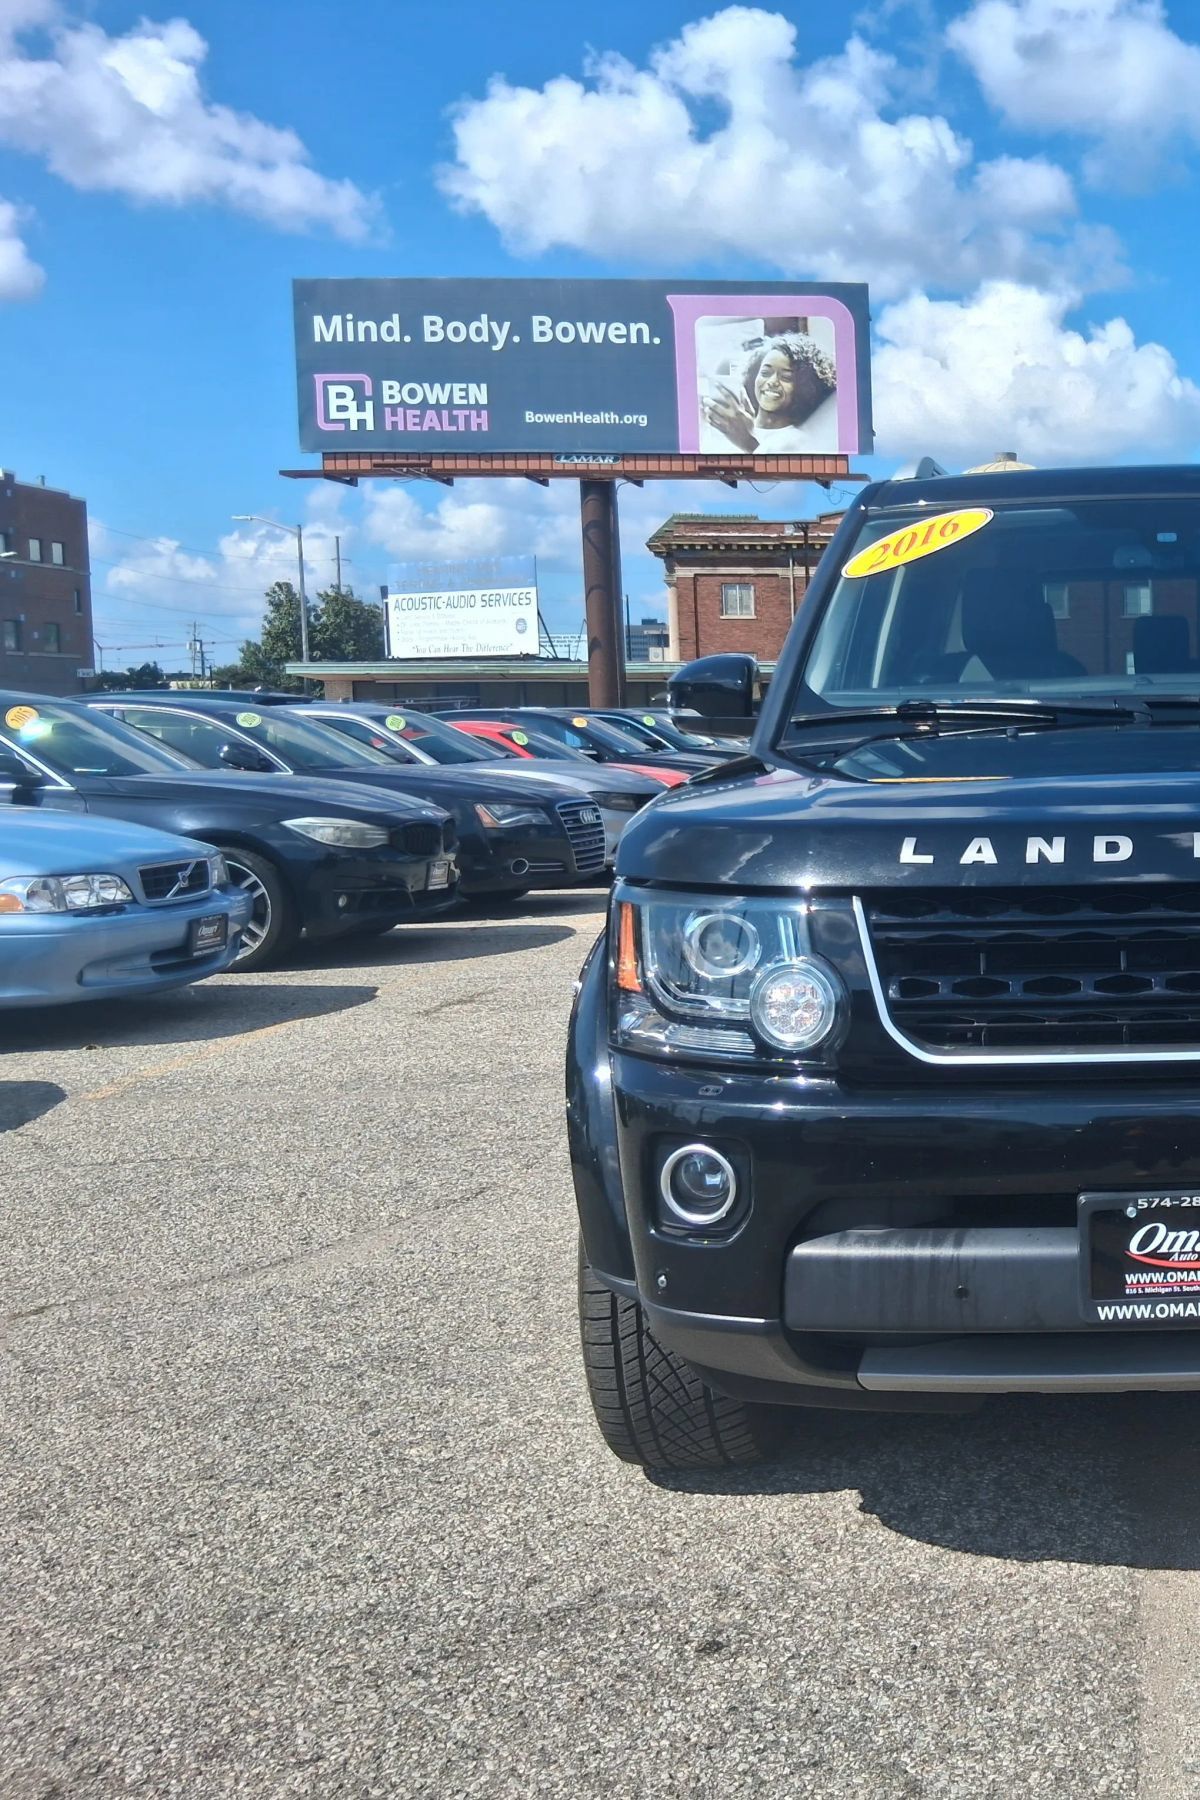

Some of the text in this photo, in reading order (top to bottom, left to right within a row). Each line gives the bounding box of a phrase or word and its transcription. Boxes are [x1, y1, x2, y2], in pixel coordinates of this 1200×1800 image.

[313, 313, 661, 350] Mind. Body. Bowen.
[382, 380, 488, 405] BOWEN
[327, 385, 374, 431] BH
[385, 407, 489, 431] HEALTH
[525, 411, 648, 426] BowenHealth.org
[559, 455, 615, 463] LAMAR
[866, 515, 960, 571] 2016
[393, 591, 532, 612] ACOUSTIC-AUDIO SERVICES
[428, 645, 441, 653] Can
[443, 644, 459, 653] Hear
[461, 643, 474, 653] The
[898, 835, 1134, 865] LAND
[1169, 1251, 1198, 1262] Auto
